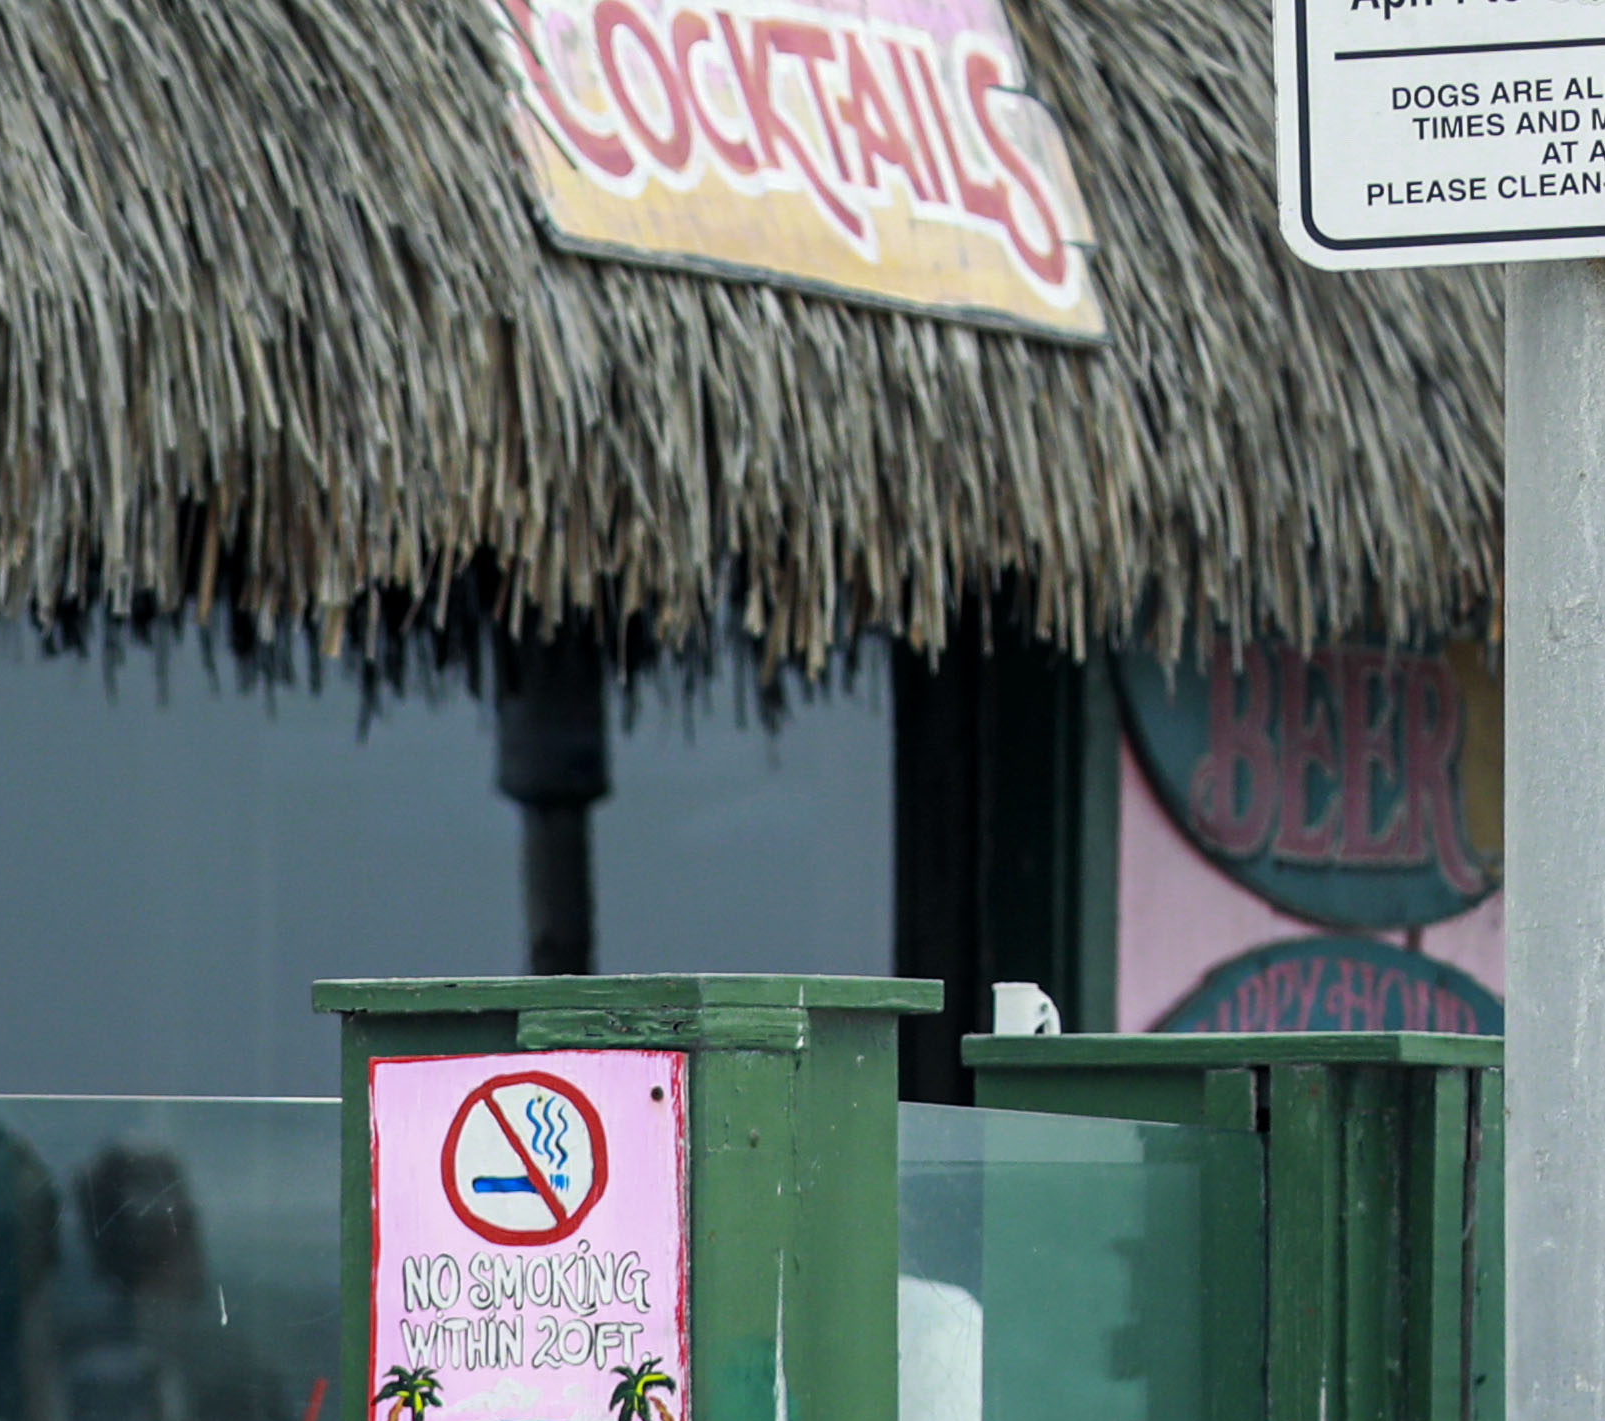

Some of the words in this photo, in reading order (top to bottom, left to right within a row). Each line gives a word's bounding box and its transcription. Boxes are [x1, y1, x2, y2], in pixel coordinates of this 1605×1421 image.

[1392, 83, 1480, 110] DOGS
[1491, 79, 1553, 105] ARE
[1413, 113, 1505, 140] TIMES
[1516, 109, 1581, 135] AND
[503, 0, 1078, 298] COCKTAILS
[1542, 140, 1578, 165] AT
[1367, 177, 1487, 207] PLEASE
[1498, 170, 1605, 200] CLEAN
[1188, 638, 1484, 897] BEER
[402, 1253, 462, 1313] NO
[470, 1240, 650, 1316] SMOKING
